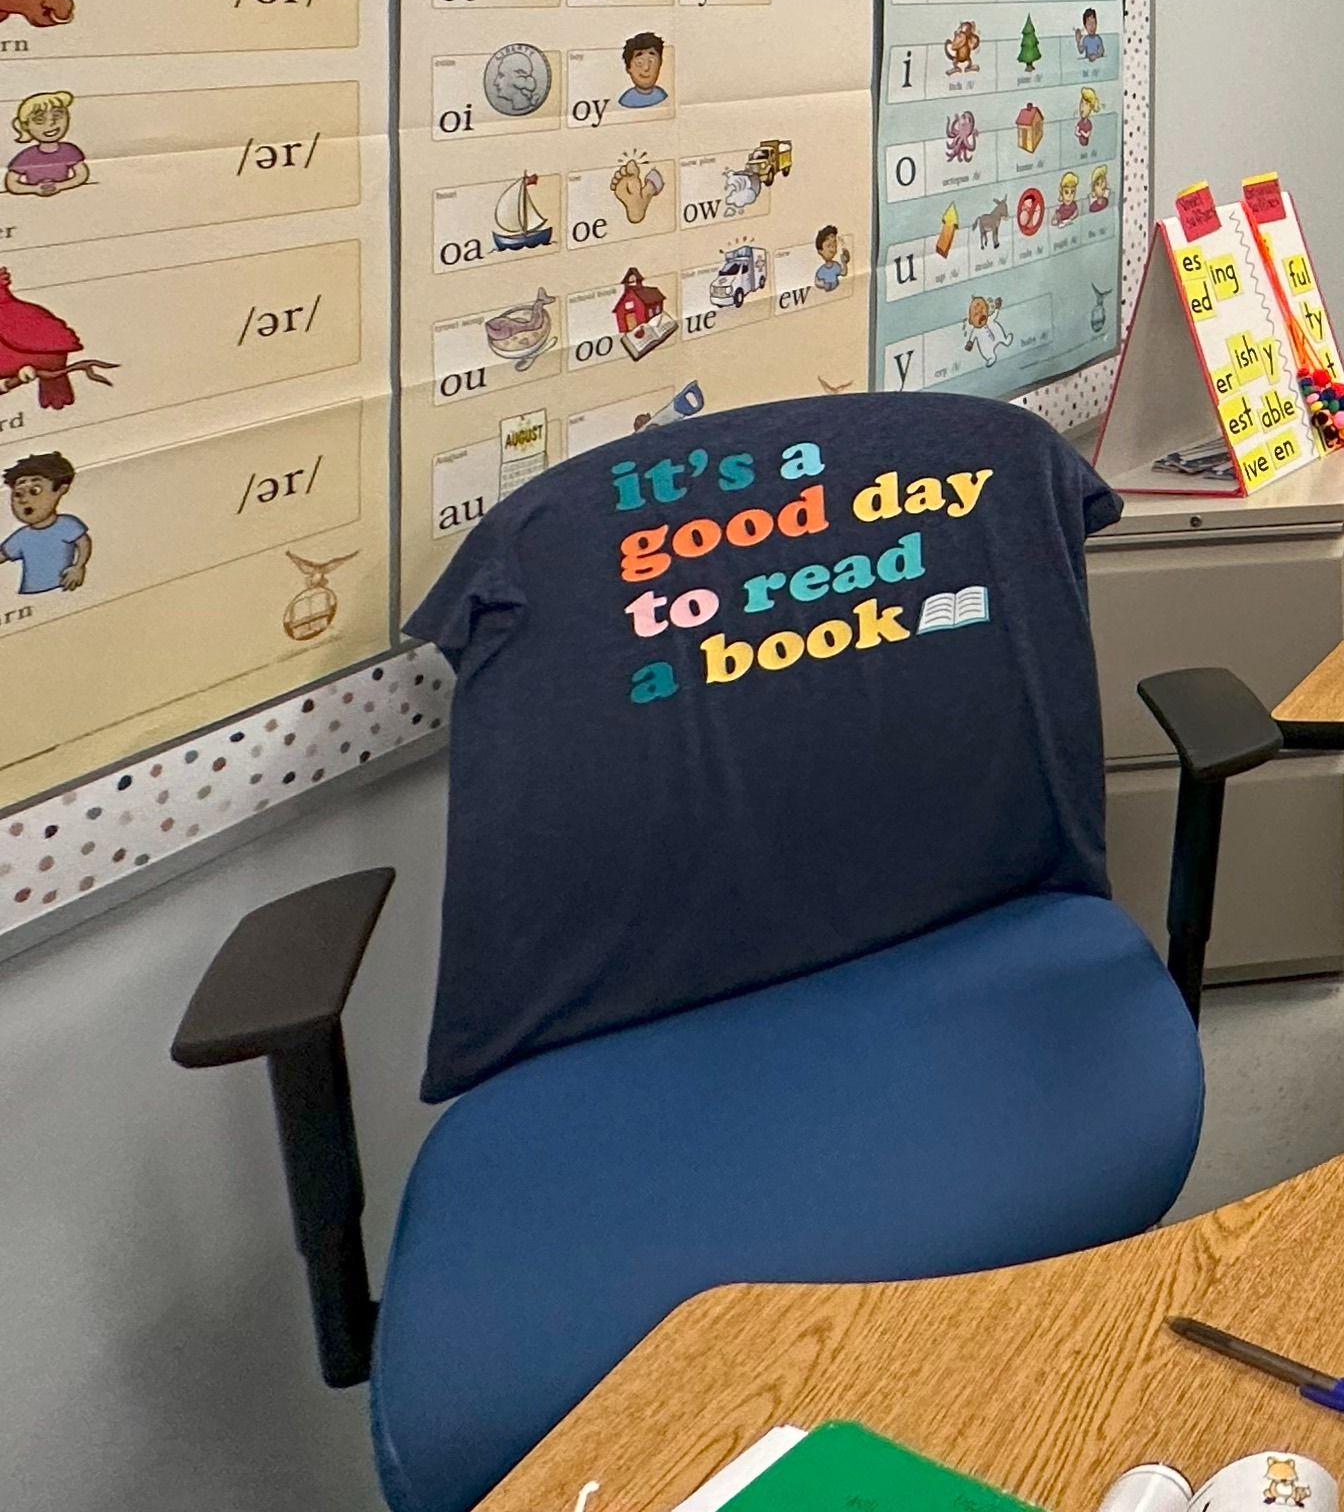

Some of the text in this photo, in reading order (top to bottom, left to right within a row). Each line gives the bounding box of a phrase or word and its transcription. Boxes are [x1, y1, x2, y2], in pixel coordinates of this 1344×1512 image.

[901, 50, 914, 88] i
[439, 105, 474, 133] oi
[572, 97, 610, 124] oy
[895, 156, 916, 187] o
[683, 200, 721, 224] ow
[572, 216, 608, 242] oe
[439, 238, 483, 265] oa
[1182, 252, 1202, 273] es
[894, 252, 917, 285] u
[1210, 262, 1240, 294] ing
[1289, 258, 1311, 287] ful
[778, 286, 811, 309] ew
[1191, 285, 1213, 314] ed
[686, 308, 717, 334] ue
[1304, 302, 1323, 339] ty
[575, 335, 614, 362] oo
[1263, 342, 1274, 375] y
[440, 367, 487, 397] ou
[894, 349, 915, 392] y
[1216, 373, 1234, 393] er
[1229, 392, 1256, 434] est
[1261, 390, 1295, 427] able
[504, 425, 543, 449] AUGUST
[1274, 440, 1295, 462] en
[779, 441, 826, 480] a
[439, 498, 485, 530] au
[619, 469, 994, 582] good day
[624, 532, 927, 638] to read
[630, 597, 911, 704] a book
